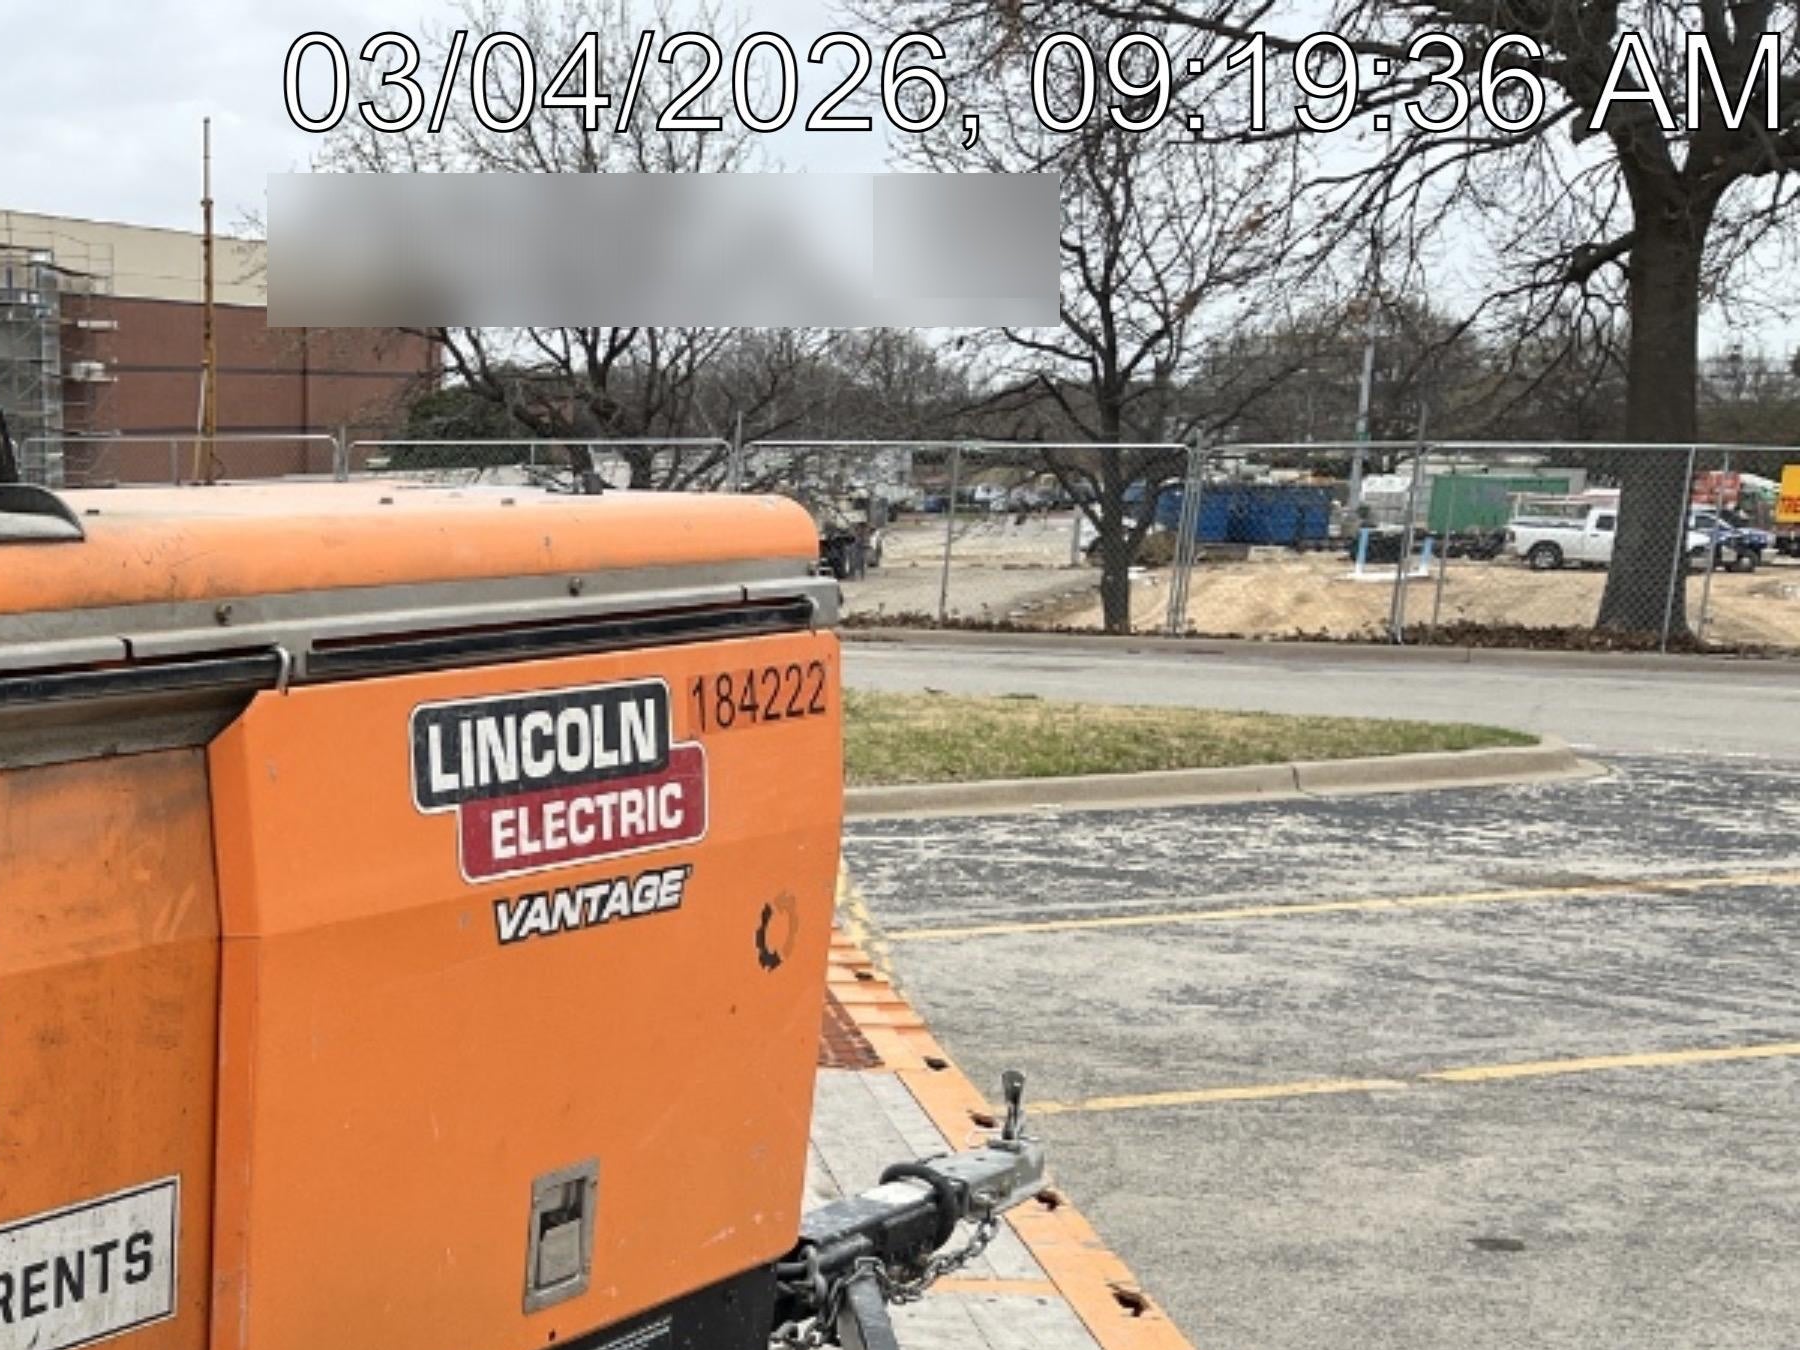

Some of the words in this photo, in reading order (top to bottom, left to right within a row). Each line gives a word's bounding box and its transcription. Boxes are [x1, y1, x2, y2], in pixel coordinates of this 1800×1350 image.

[691, 659, 828, 733] 184222
[426, 698, 659, 794] LINCOLN
[490, 782, 684, 860] ELECTRIC
[496, 867, 688, 943] VANTAGE
